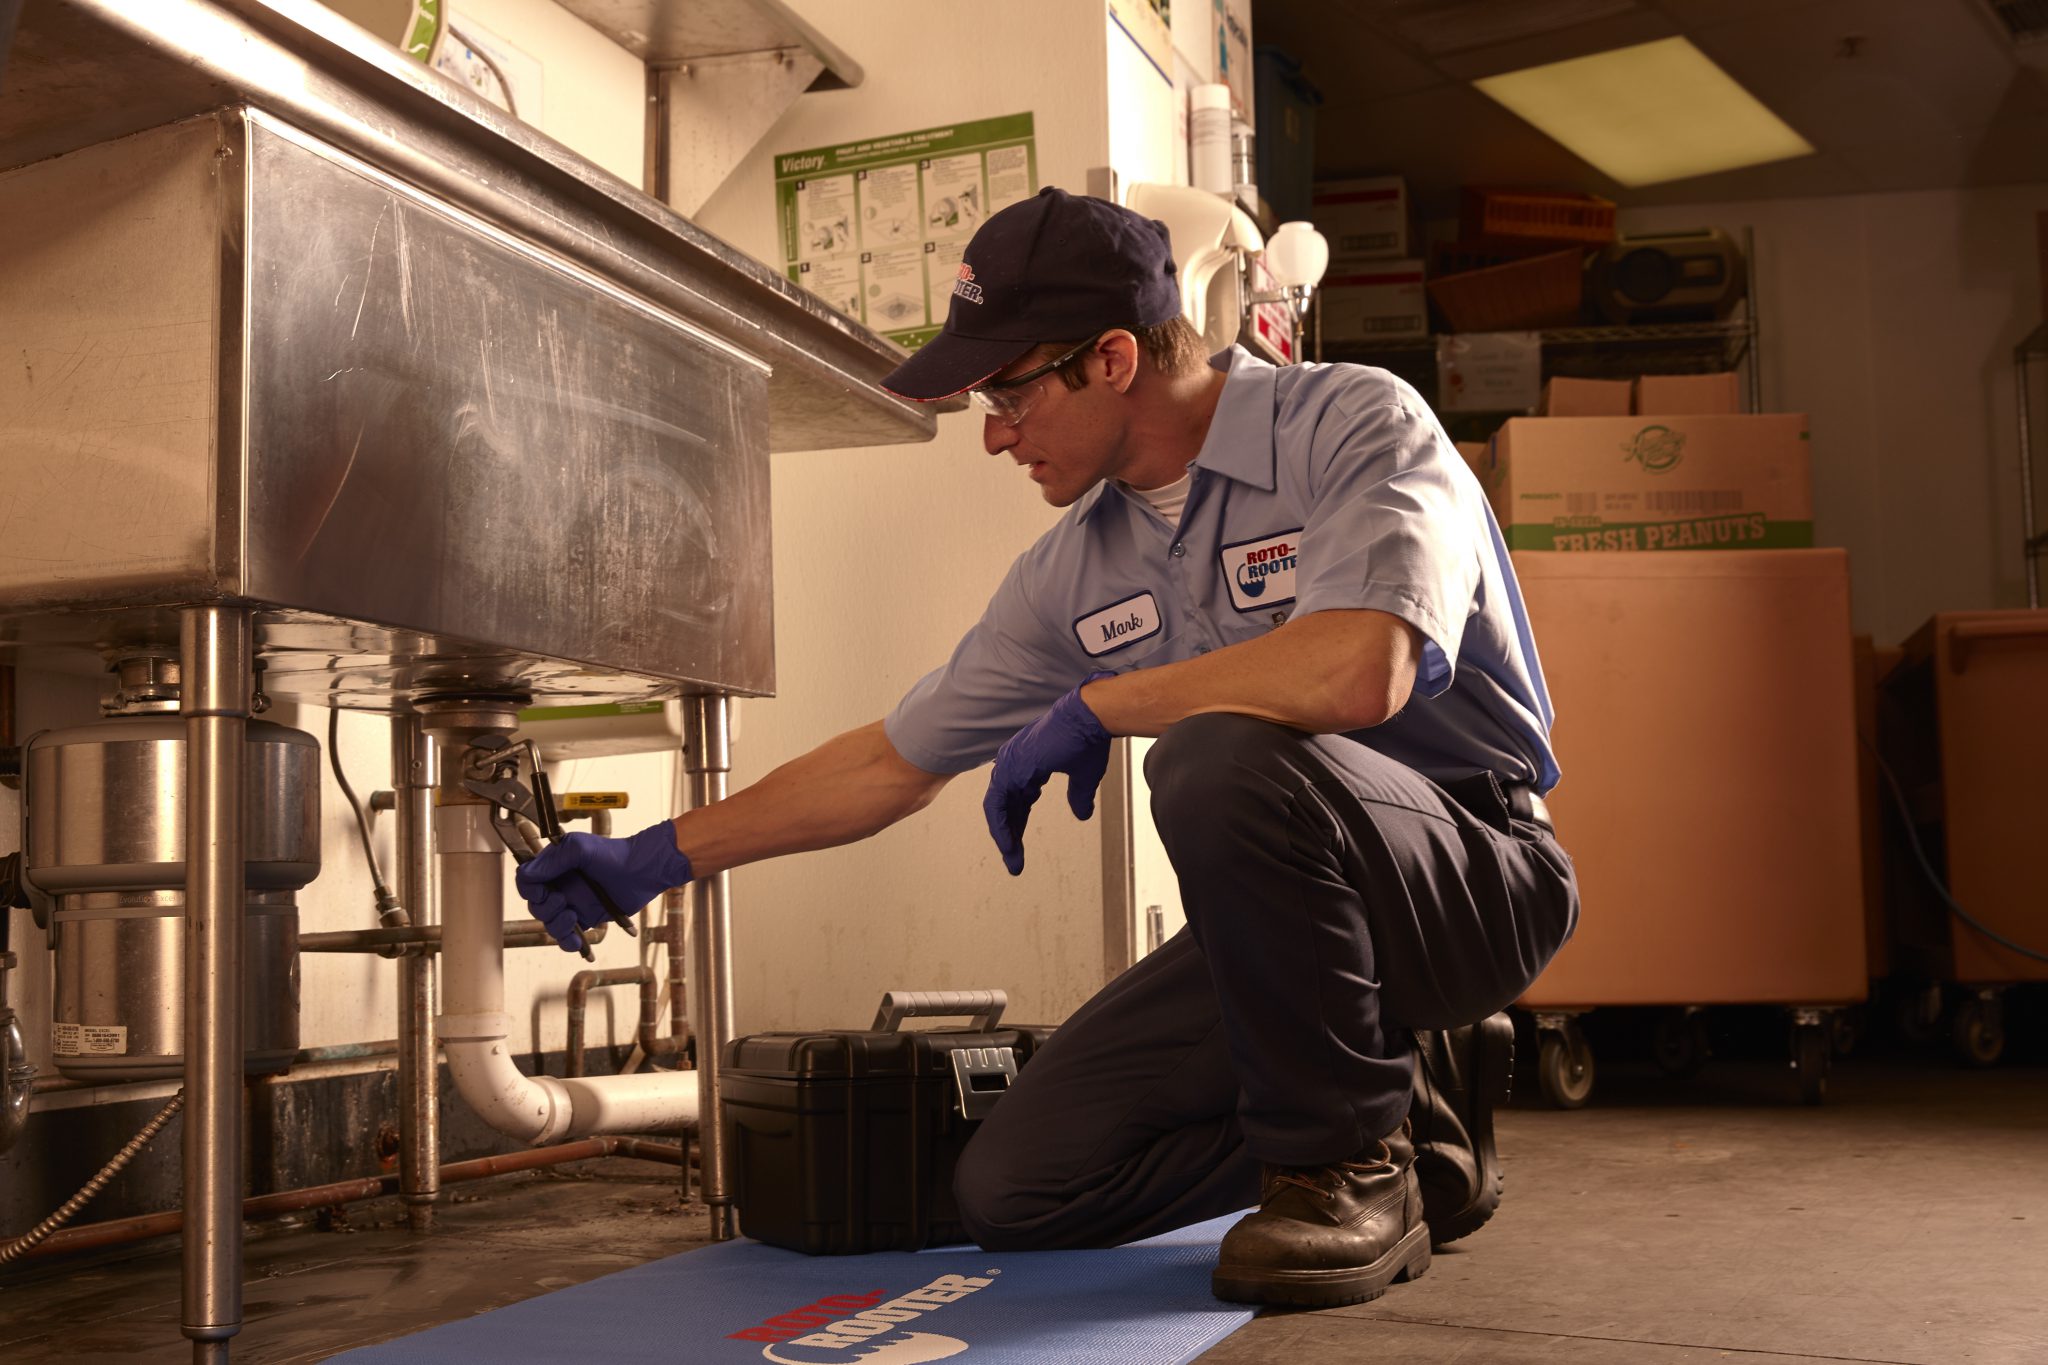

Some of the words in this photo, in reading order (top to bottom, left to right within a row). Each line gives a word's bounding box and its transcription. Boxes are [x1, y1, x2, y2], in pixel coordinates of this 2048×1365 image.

[782, 155, 825, 173] Victory
[1552, 527, 1638, 552] FRESH
[1643, 515, 1766, 550] PEANUTS
[1246, 543, 1297, 565] ROTO-
[1100, 612, 1143, 643] Mark
[722, 1288, 889, 1344] ROTO-
[787, 1273, 995, 1349] ROOTER
